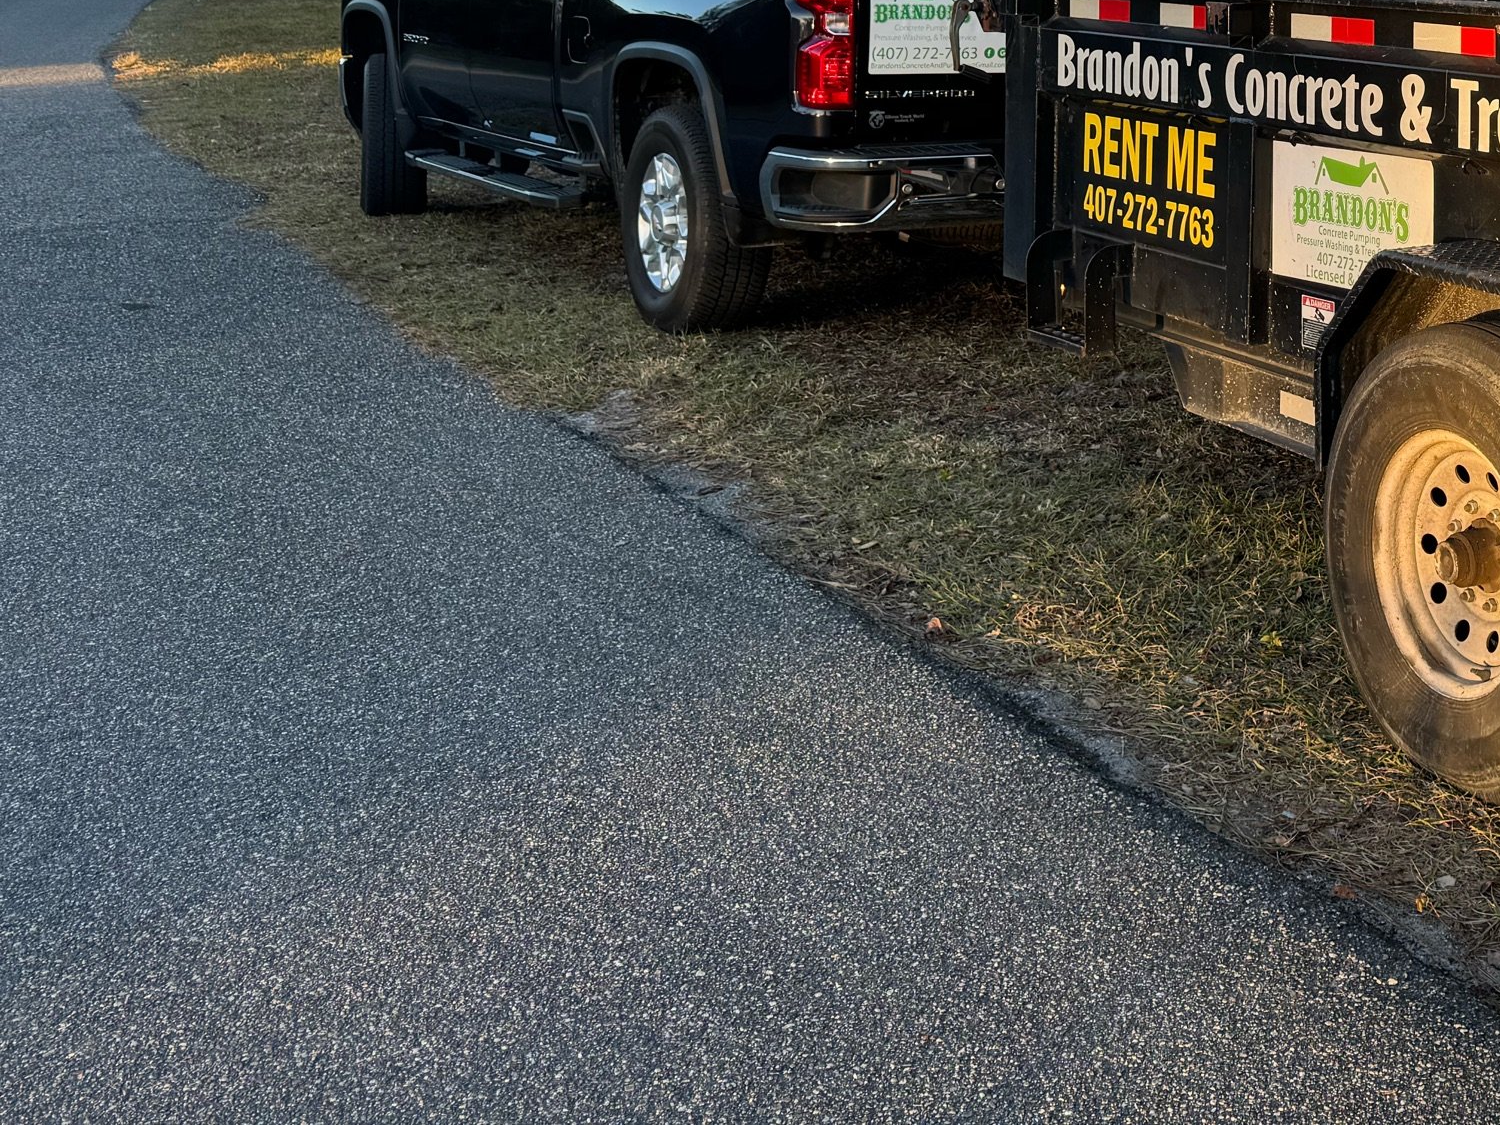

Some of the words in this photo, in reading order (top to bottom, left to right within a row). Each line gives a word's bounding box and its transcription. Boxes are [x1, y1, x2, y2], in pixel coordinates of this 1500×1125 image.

[872, 46, 909, 62] (407)
[1057, 33, 1212, 109] Brandon's
[1225, 53, 1384, 137] Concrete
[1400, 73, 1433, 145] &
[1083, 112, 1159, 186] RENT
[1166, 125, 1217, 199] ME
[1083, 183, 1214, 249] 407-272-7763
[1293, 187, 1409, 243] BRANDON'S
[1296, 233, 1324, 248] Pressure
[1324, 238, 1354, 256] Washing
[1354, 244, 1361, 255] &
[1361, 245, 1376, 257] Tree
[1318, 225, 1348, 240] Concrete
[1349, 230, 1381, 248] Pumping
[1306, 263, 1346, 285] Licensed
[1347, 272, 1355, 286] &
[1310, 299, 1331, 309] DANGER
